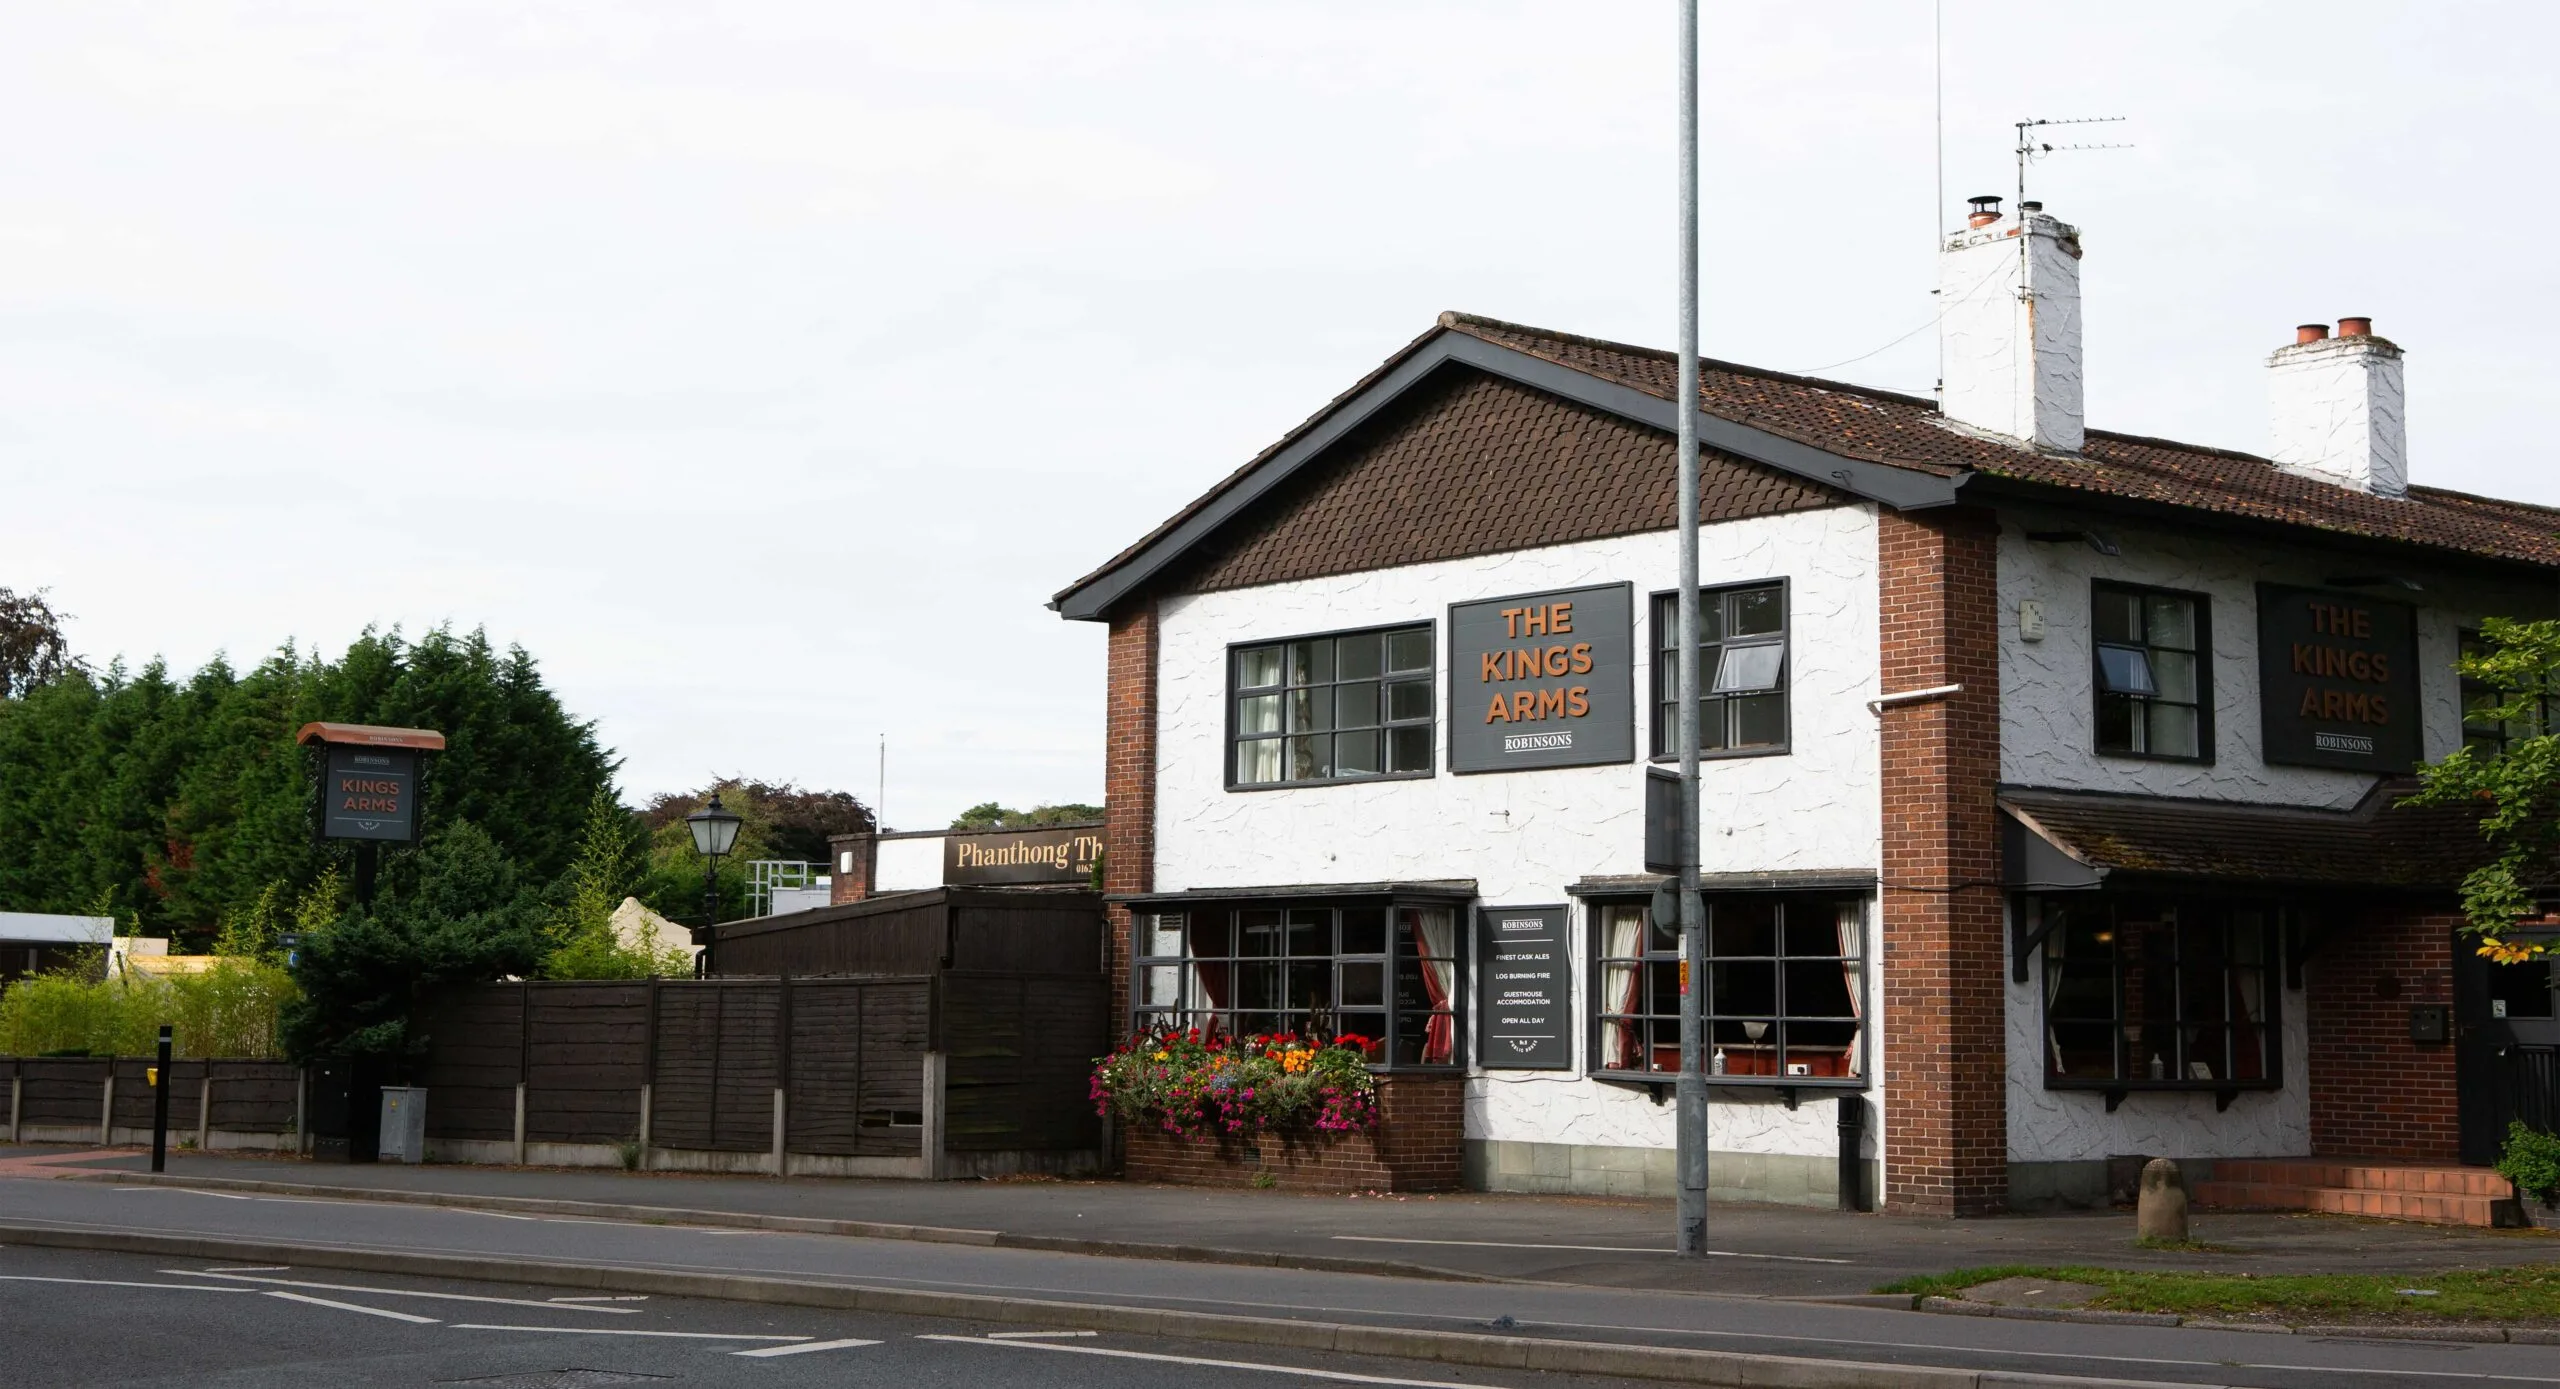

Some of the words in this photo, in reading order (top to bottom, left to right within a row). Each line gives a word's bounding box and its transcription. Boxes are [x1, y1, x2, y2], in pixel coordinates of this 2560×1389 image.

[1501, 602, 1572, 638] THE
[2309, 603, 2371, 638] THE
[1481, 643, 1593, 682] KINGS
[2292, 643, 2390, 682] KINGS
[1485, 686, 1590, 724] ARMS
[2300, 687, 2389, 724] ARMS
[1504, 734, 1572, 751] ROBINSONS
[2315, 734, 2373, 751] ROBINSONS
[341, 779, 400, 795] KINGS
[343, 797, 398, 812] ARMS
[956, 840, 1069, 869] Phanthong
[1074, 833, 1103, 861] Th
[1076, 863, 1095, 873] 0162
[1502, 920, 1544, 930] ROBINSONS
[1509, 972, 1536, 980] BURNING
[1496, 998, 1551, 1006] ACCOMMODATION
